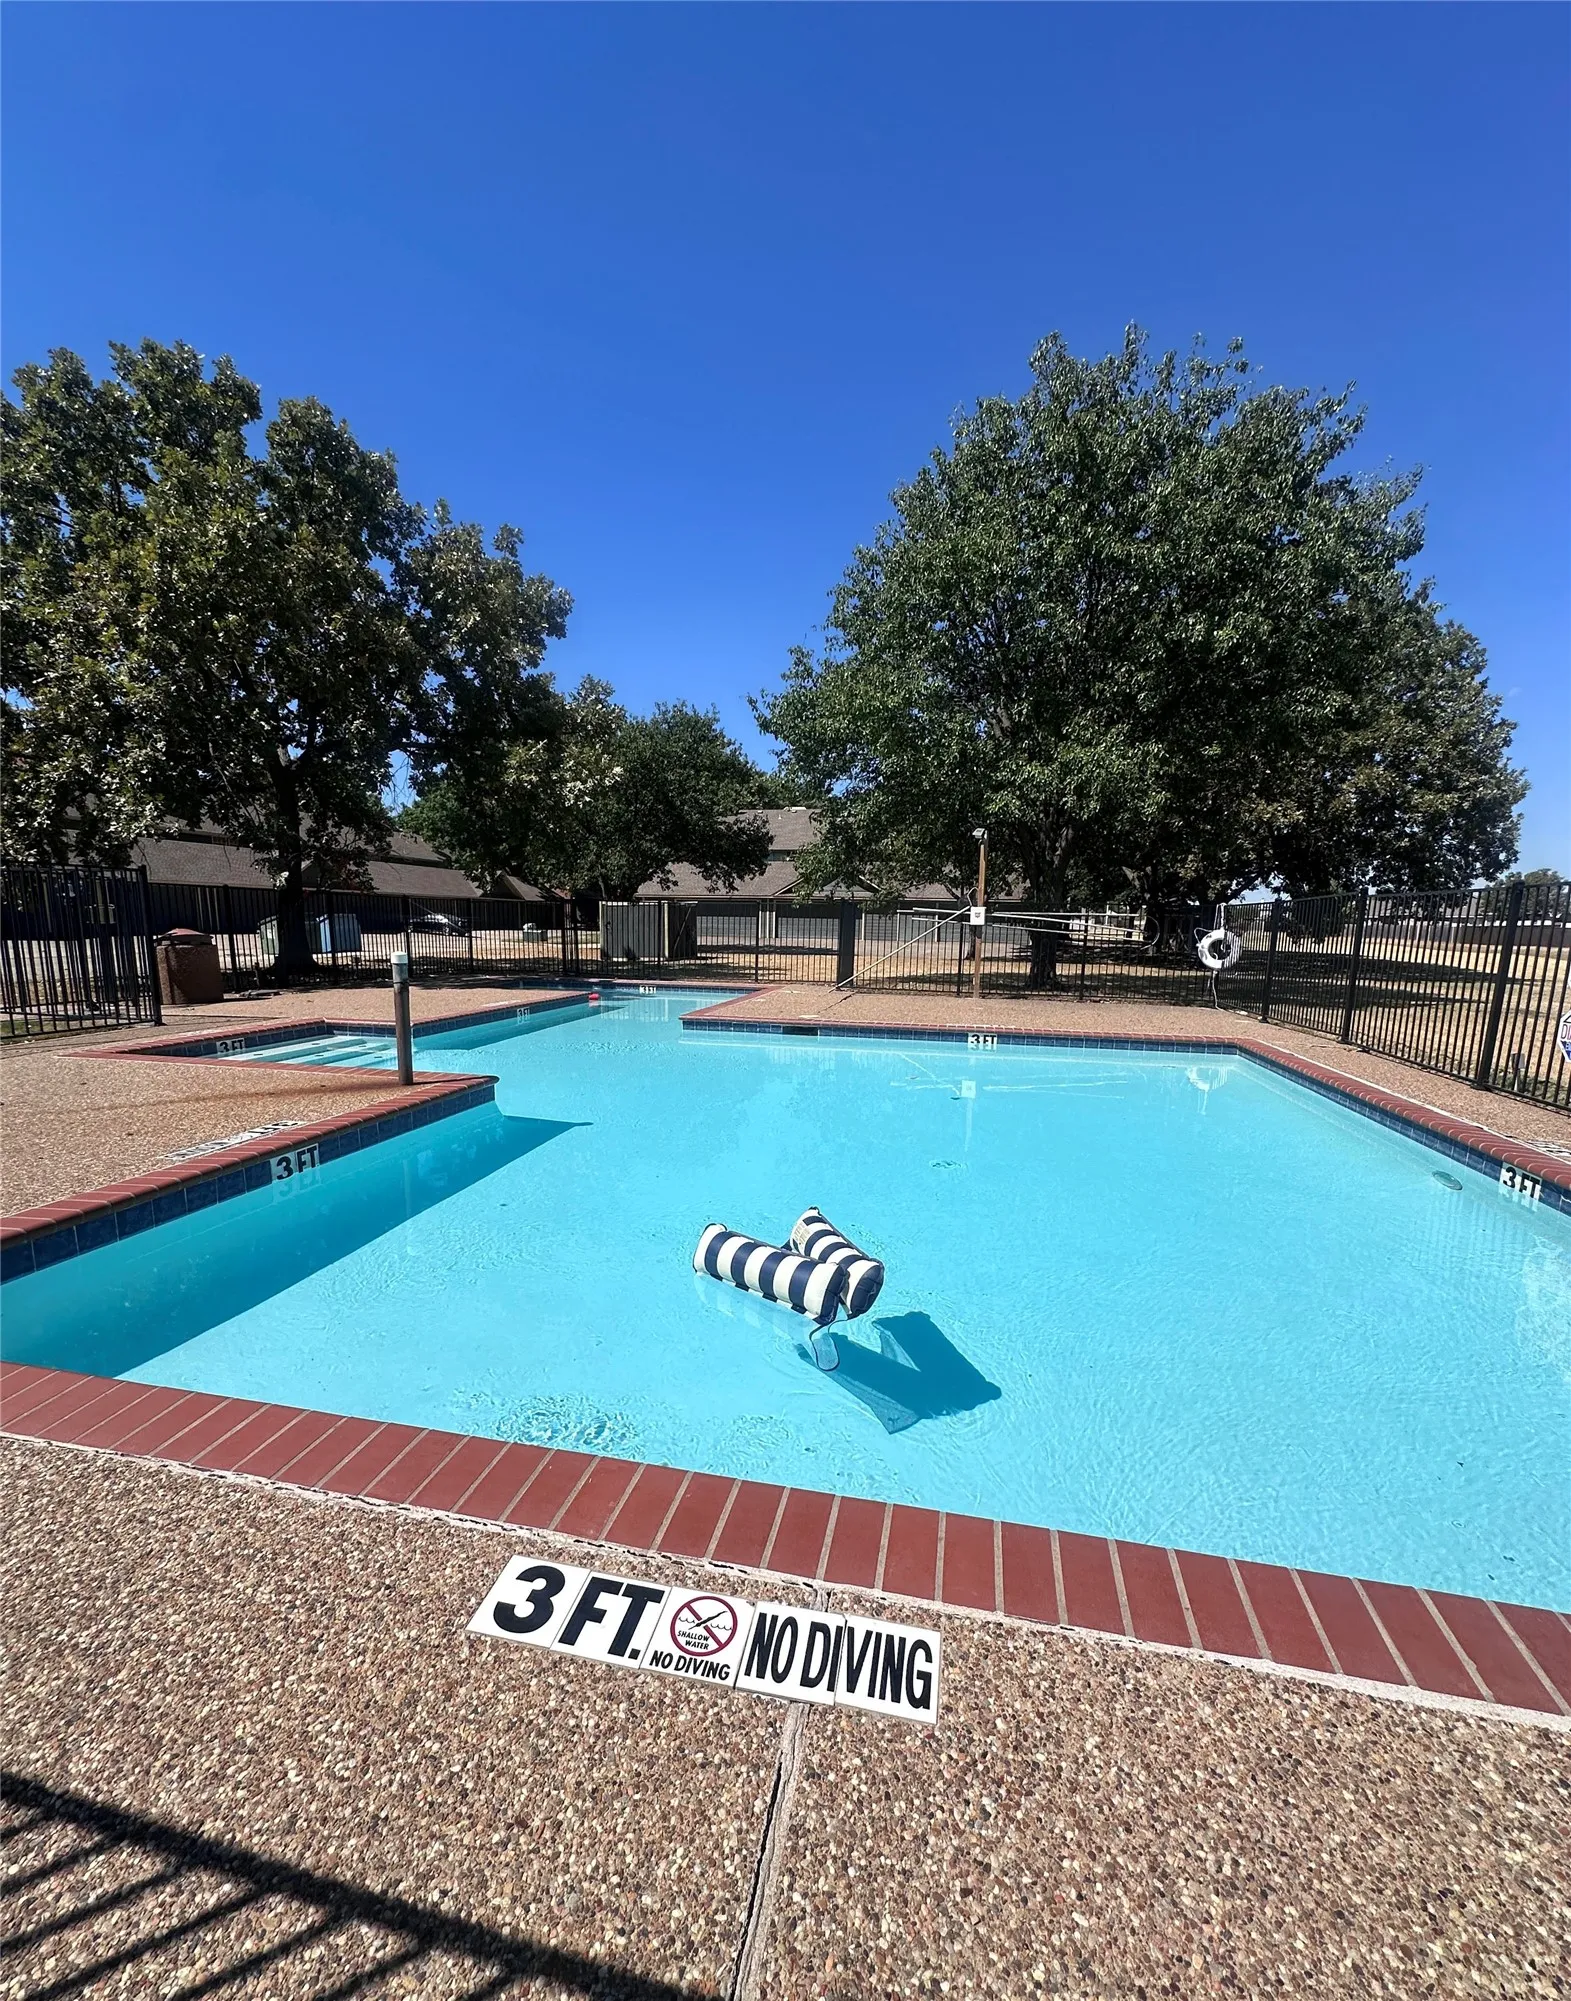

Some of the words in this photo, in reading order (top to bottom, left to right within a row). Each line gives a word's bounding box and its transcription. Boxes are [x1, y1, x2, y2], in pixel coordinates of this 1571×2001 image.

[220, 1041, 230, 1053] 3
[231, 1039, 244, 1051] FT
[970, 1034, 980, 1044] 3
[983, 1034, 997, 1045] FT
[276, 1155, 294, 1180] 3
[296, 1145, 318, 1173] FT
[1503, 1166, 1517, 1189] 3
[1519, 1173, 1541, 1199] FT
[493, 1564, 567, 1634] 3
[558, 1576, 665, 1660] FT.
[677, 1630, 710, 1642] SHALLOW
[685, 1640, 710, 1650] WATER
[649, 1650, 674, 1669] NO
[673, 1654, 731, 1681] DIVING
[743, 1612, 799, 1683] NO
[800, 1622, 934, 1710] DIVING
